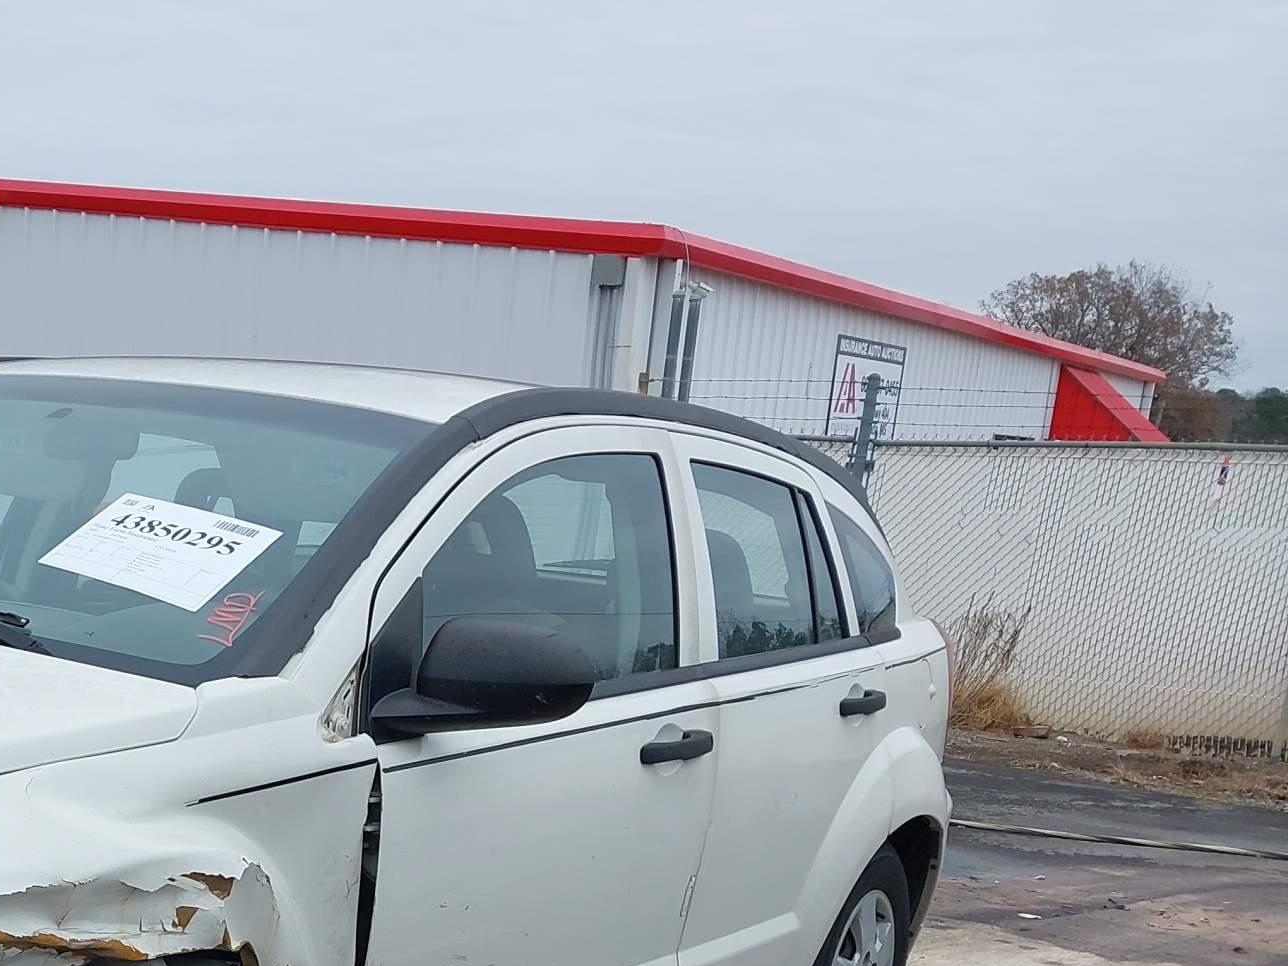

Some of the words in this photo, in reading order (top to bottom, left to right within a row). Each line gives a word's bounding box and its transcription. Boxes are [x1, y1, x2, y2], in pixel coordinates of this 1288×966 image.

[840, 338, 869, 356] INSURANCE
[868, 343, 882, 358] AUTO
[881, 346, 905, 362] AUCTIONS
[110, 513, 242, 556] 43850295
